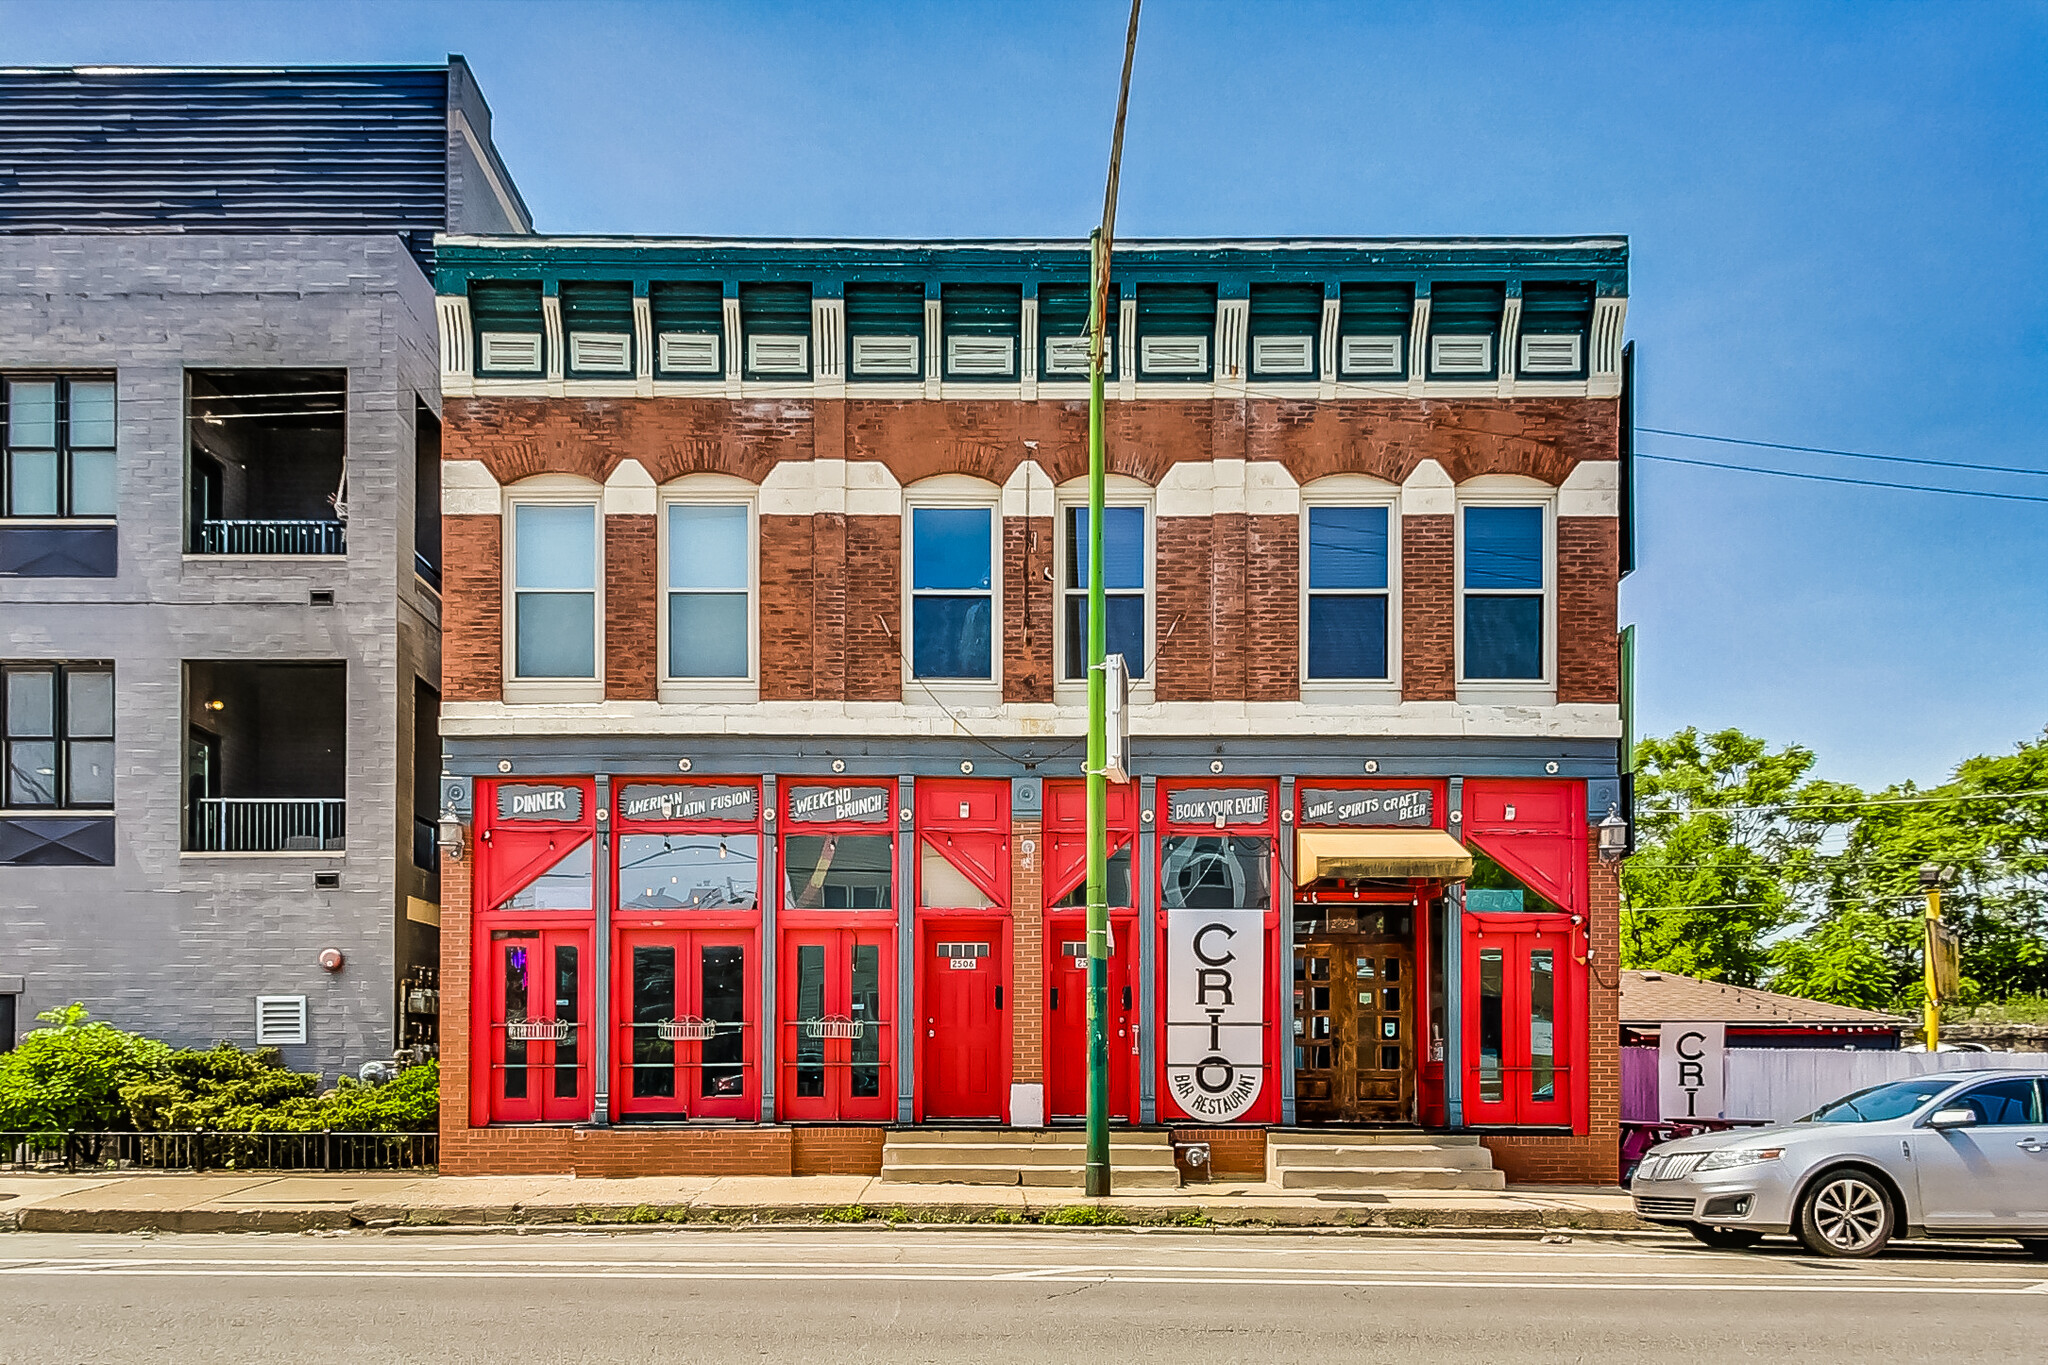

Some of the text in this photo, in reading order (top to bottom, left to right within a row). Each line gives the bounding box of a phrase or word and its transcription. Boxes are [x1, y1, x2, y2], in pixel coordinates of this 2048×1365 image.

[513, 791, 566, 813] DINNER
[676, 790, 751, 818] LATIN FUSION
[797, 788, 851, 813] WEEKEND
[836, 795, 882, 819] BRUNCH
[1176, 796, 1264, 819] BOOK YOUR EVENT
[1308, 792, 1419, 819] WINE SPIRITS CRAFT
[1399, 804, 1426, 820] BEER
[952, 960, 974, 968] 2506
[1077, 959, 1088, 967] 25
[1193, 923, 1237, 1093] CRIO
[1676, 1031, 1707, 1117] CRI
[1174, 1074, 1256, 1115] BAR RESTAURANT
